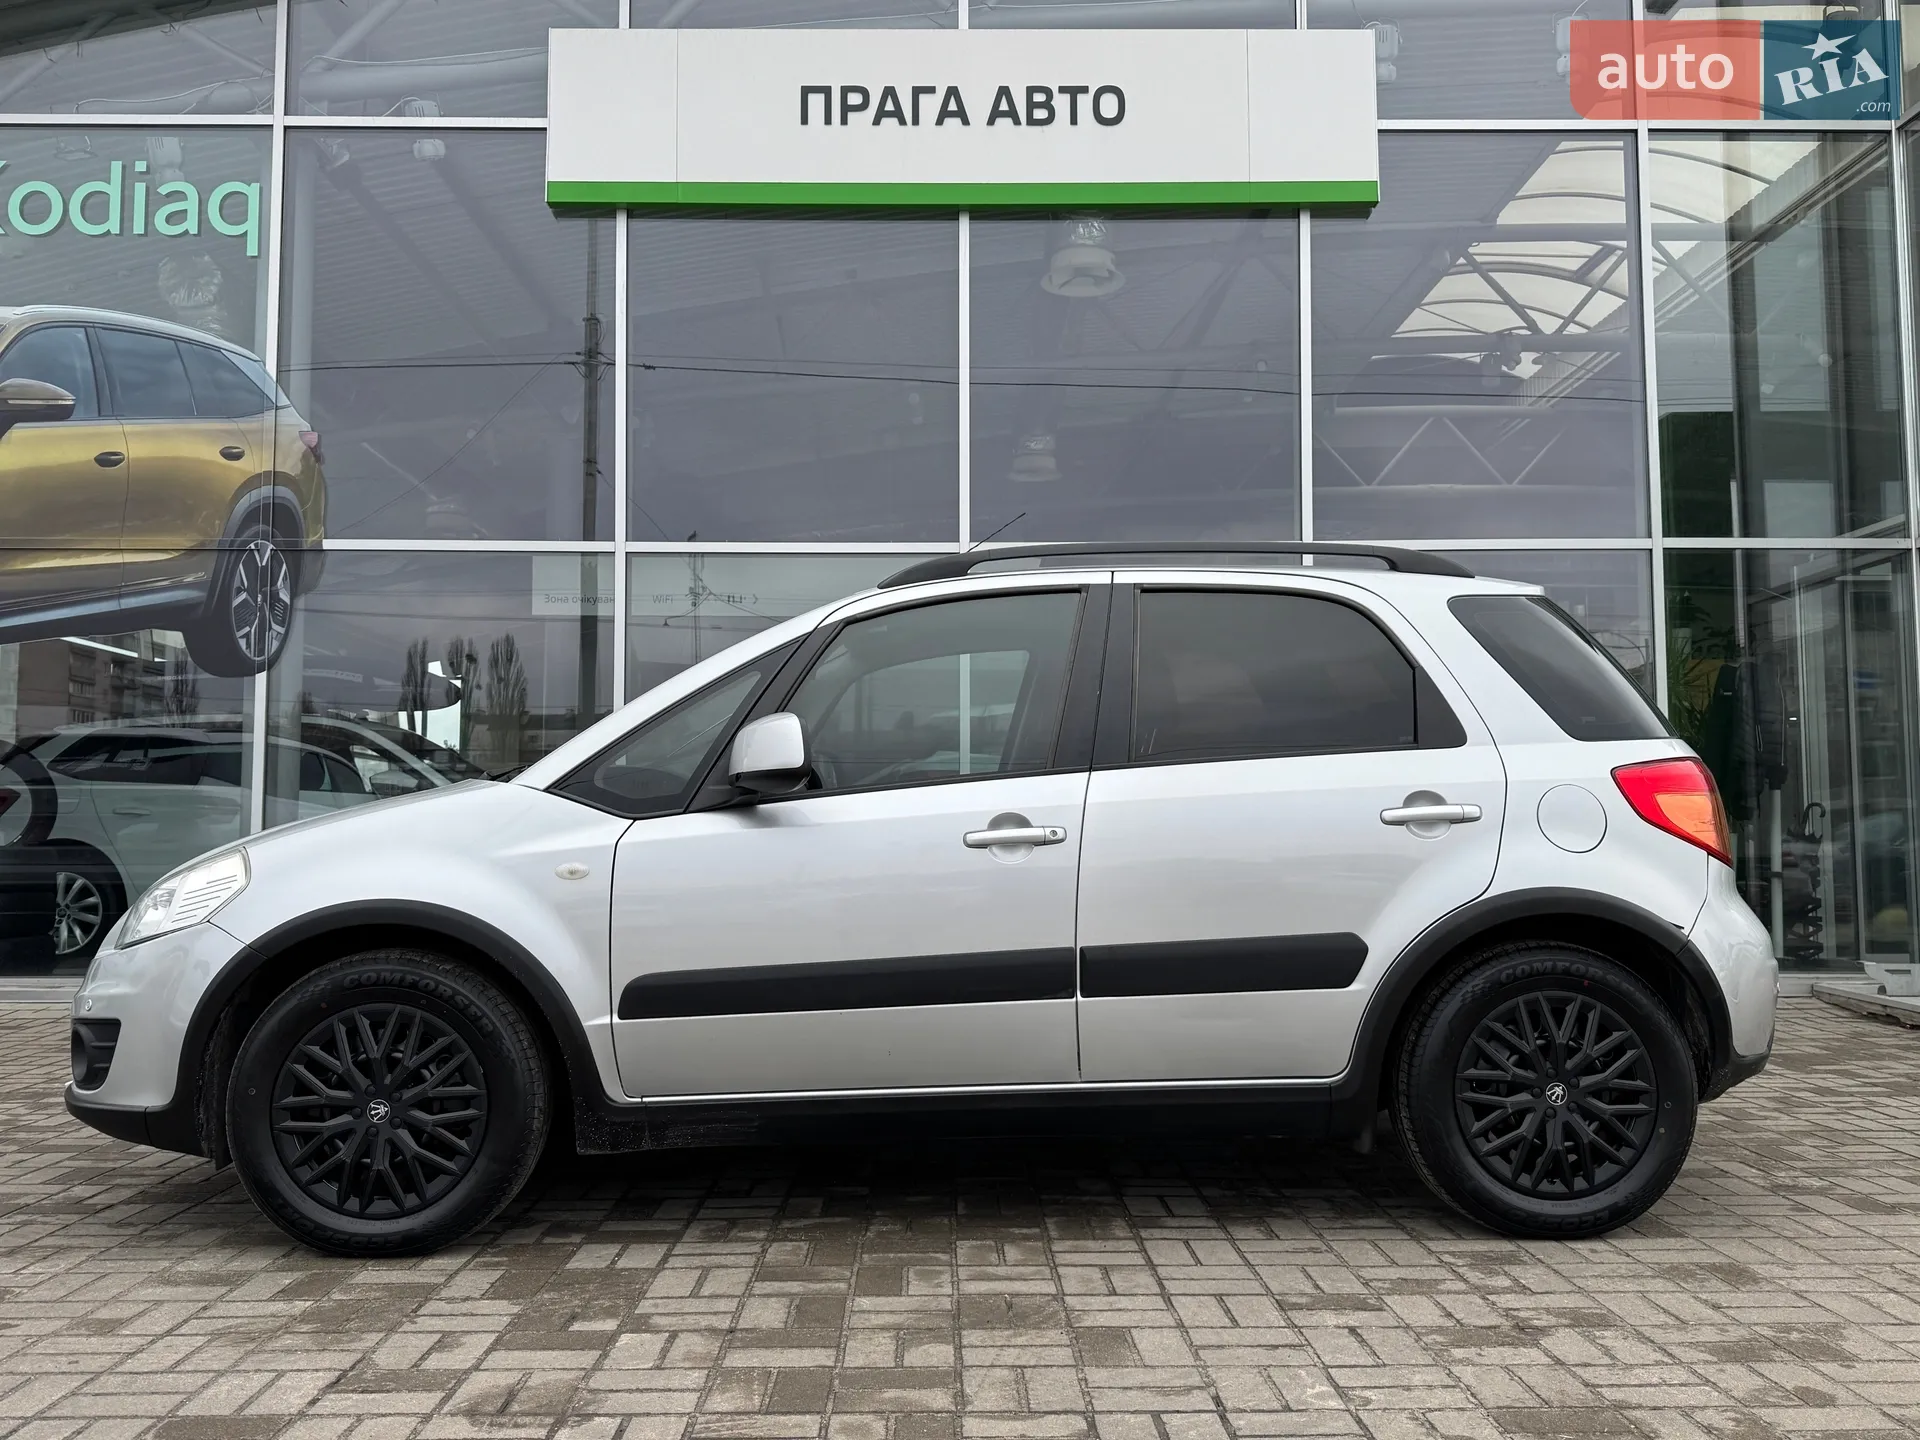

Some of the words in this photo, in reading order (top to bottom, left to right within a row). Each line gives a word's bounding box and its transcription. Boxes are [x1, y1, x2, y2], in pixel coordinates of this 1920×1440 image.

[800, 85, 970, 126] ПРАГА
[987, 85, 1126, 126] АВТО
[0, 160, 262, 257] odiaq
[544, 594, 569, 603] Зона
[652, 595, 674, 604] WiFi
